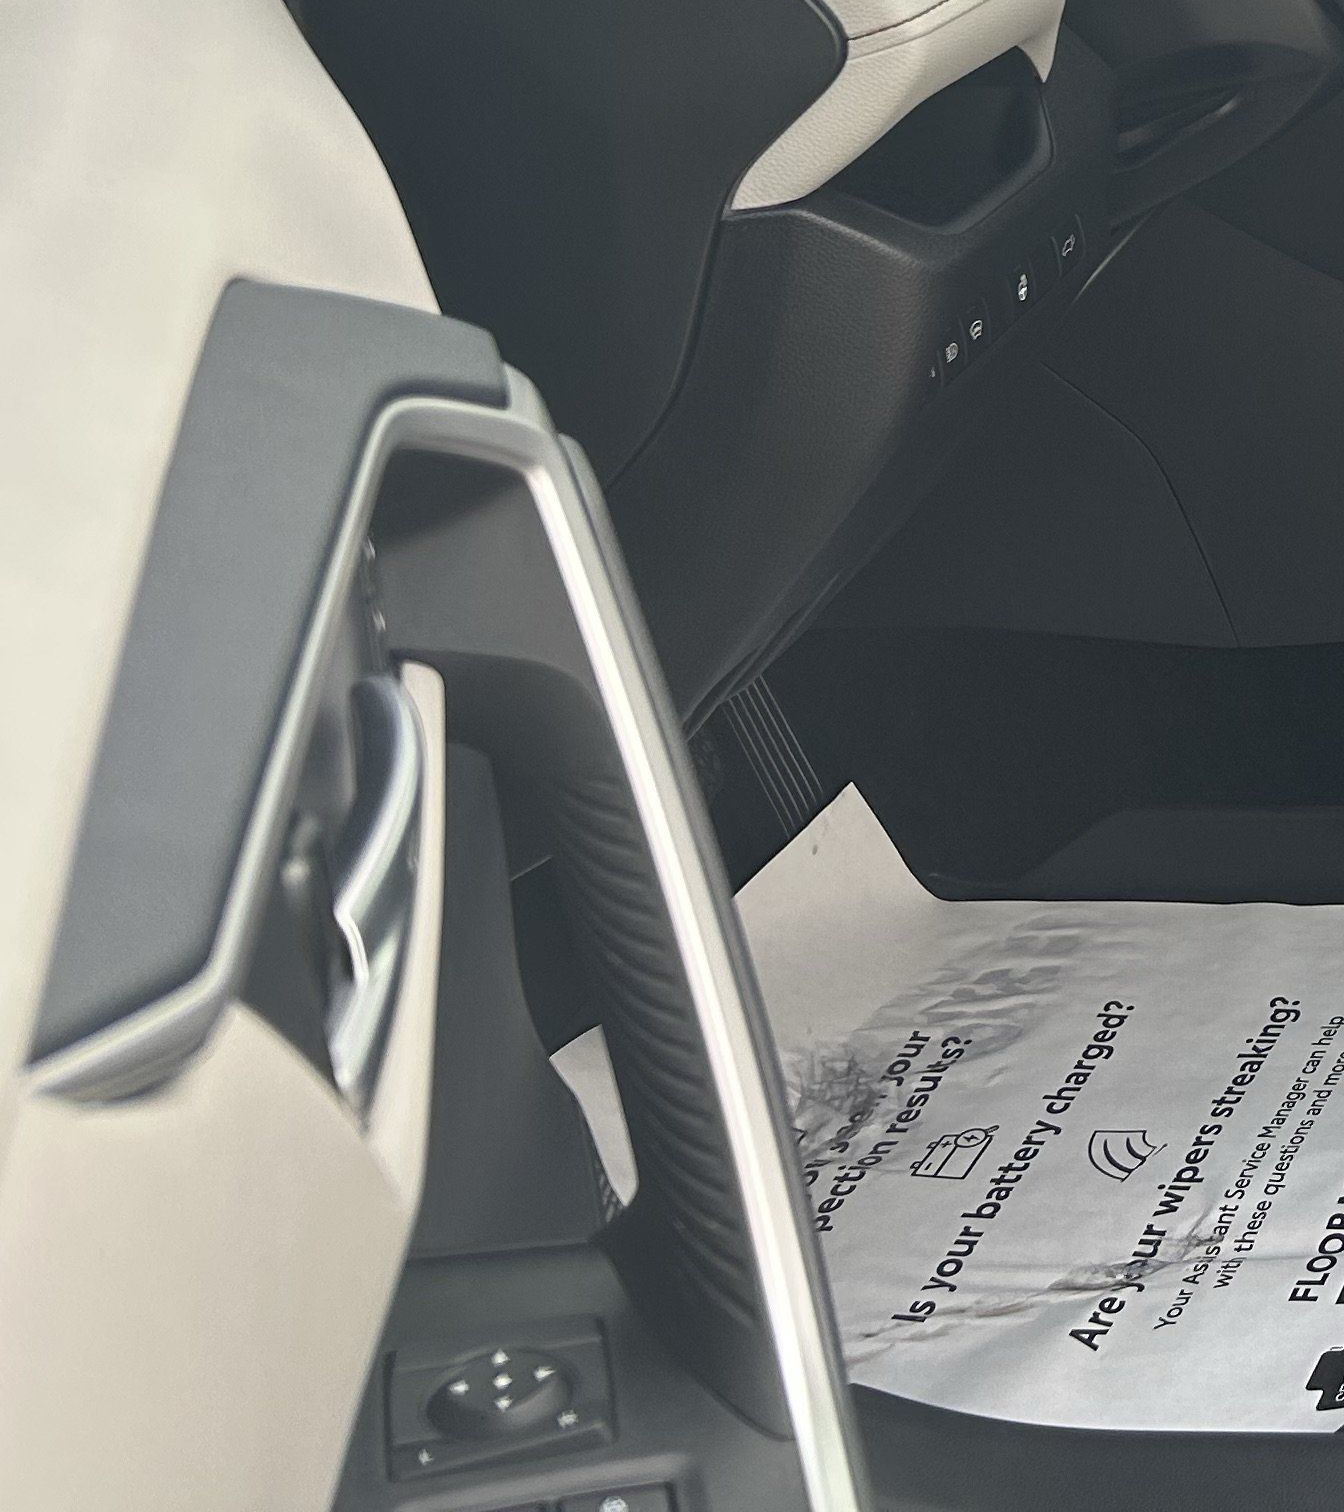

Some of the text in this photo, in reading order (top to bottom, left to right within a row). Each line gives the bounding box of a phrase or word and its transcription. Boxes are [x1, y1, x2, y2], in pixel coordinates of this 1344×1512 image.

[886, 1035, 972, 1134] results?
[891, 1000, 1135, 1322] Is your battery charged?
[1069, 1296, 1125, 1351] Are
[1153, 1123, 1223, 1217] wipers
[1211, 996, 1301, 1119] streaking?
[1153, 1288, 1193, 1330] Your
[1190, 1202, 1239, 1286] Asisant
[1225, 1141, 1271, 1201] Service
[1258, 1076, 1310, 1138] Manager
[1302, 1050, 1326, 1077] can
[1213, 1255, 1244, 1289] with
[1234, 1200, 1272, 1253] these
[1264, 1119, 1314, 1195] questions
[1306, 1088, 1332, 1117] and
